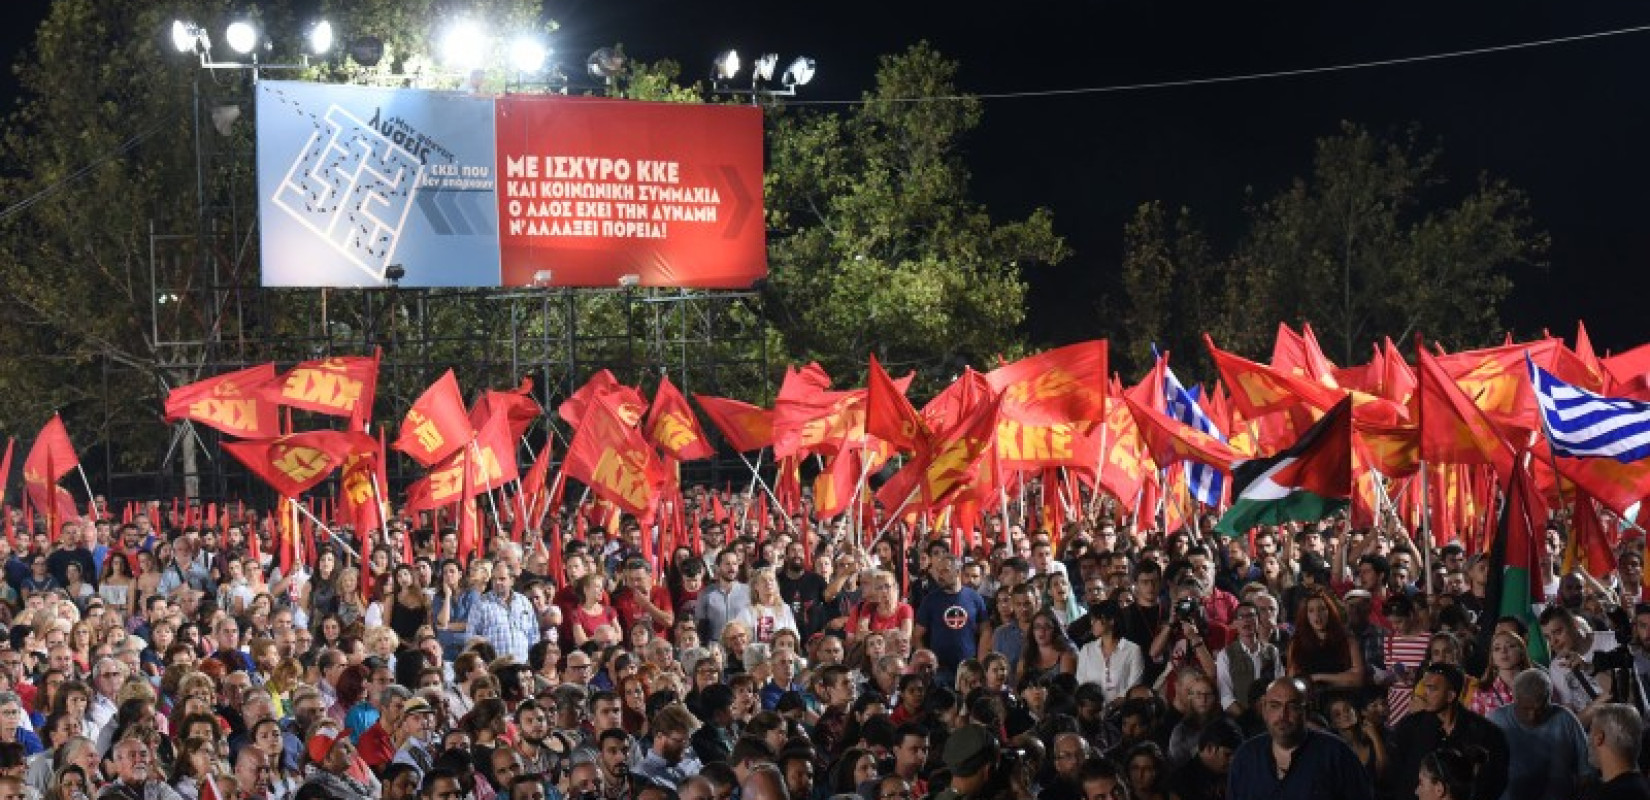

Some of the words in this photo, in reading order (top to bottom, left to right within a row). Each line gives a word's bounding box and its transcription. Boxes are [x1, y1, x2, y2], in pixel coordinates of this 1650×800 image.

[506, 153, 539, 178] ΜΕ
[545, 156, 630, 182] ΙΣΧΥΡΟ
[636, 159, 680, 184] ΚΚΕ
[506, 181, 537, 198] ΚΑΙ
[540, 182, 634, 202] ΚΟΙΝΩΝΙΚΗ
[638, 185, 721, 205] ΣΥΜΜΑΧΙΑ
[508, 201, 523, 217] Ο
[525, 201, 573, 218] ΛΑΟΣ
[576, 202, 612, 219] ΕΧΕΙ
[616, 203, 648, 220] ΤΗΝ
[651, 204, 717, 223] ΔΥΝΑΜΗ
[601, 220, 668, 239] ΠΟΡΕΙΑ!
[997, 419, 1073, 461] ΚΚΕ
